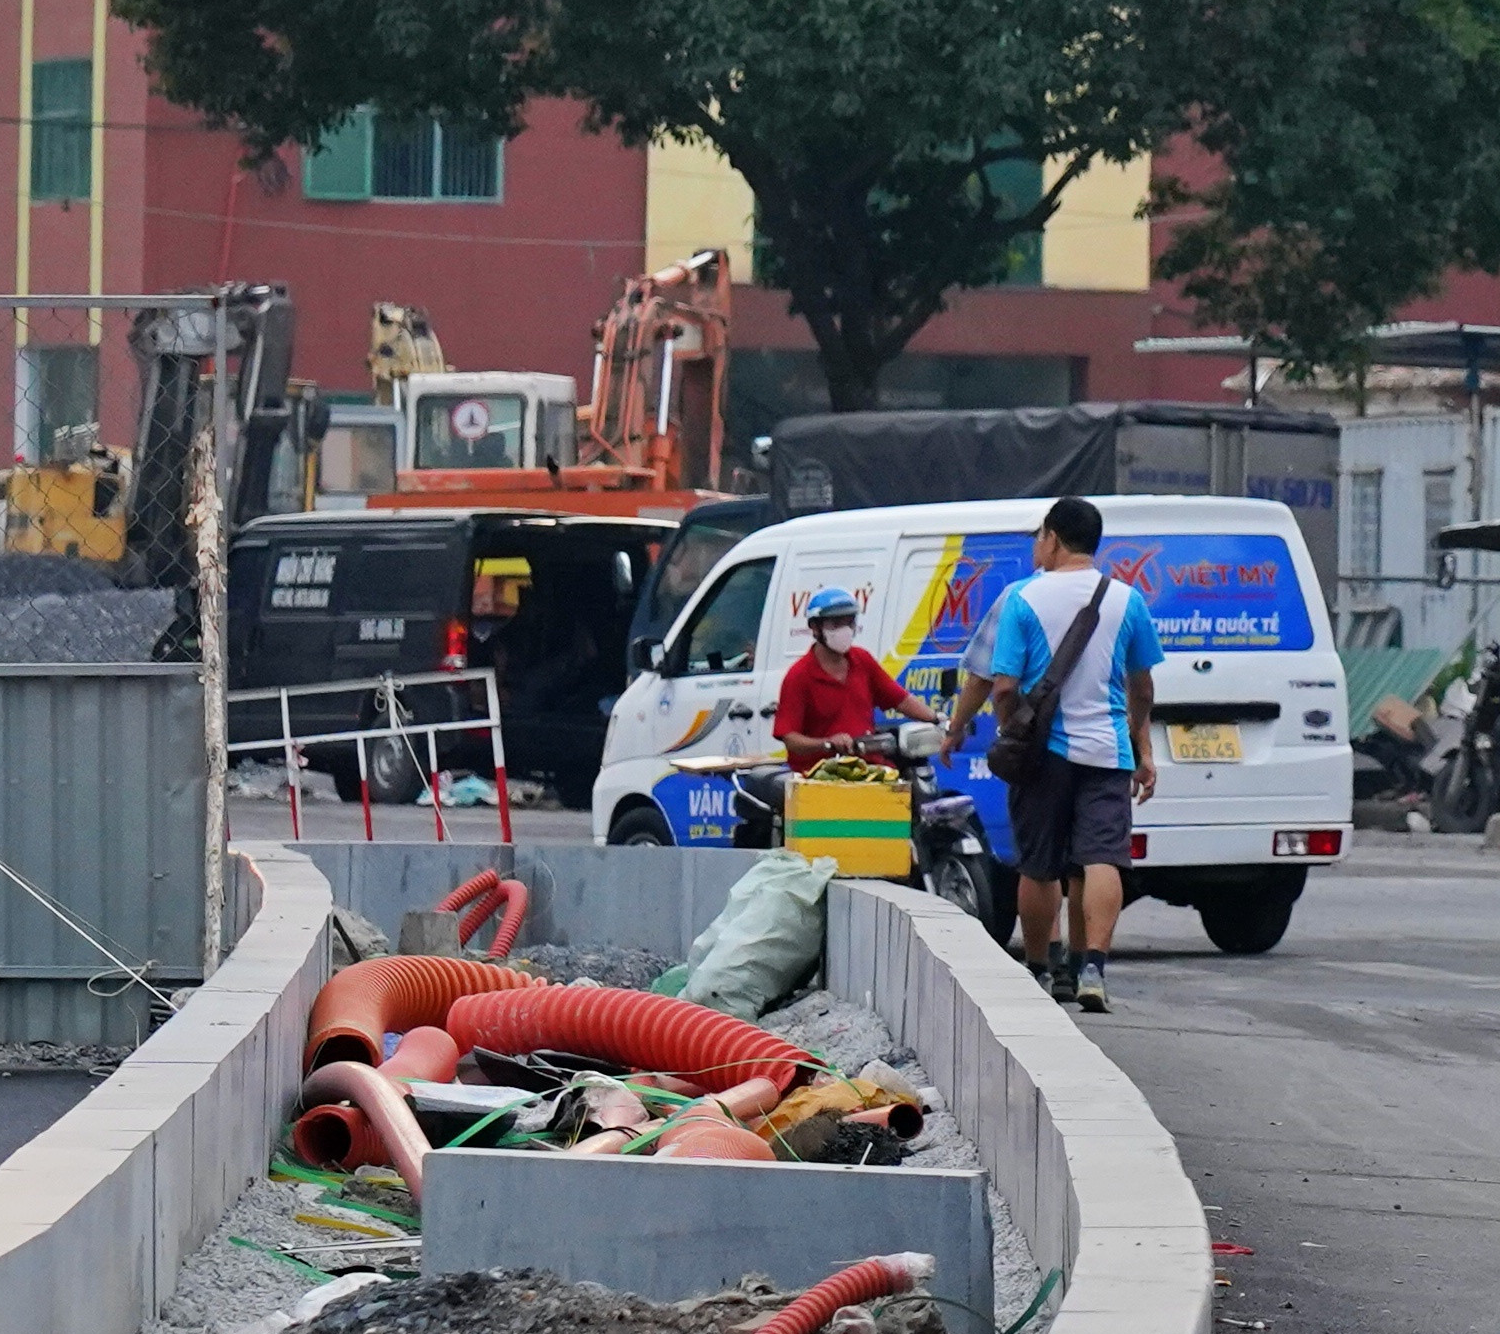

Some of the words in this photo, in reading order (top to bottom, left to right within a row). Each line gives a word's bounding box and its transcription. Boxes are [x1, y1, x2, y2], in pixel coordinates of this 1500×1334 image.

[1165, 560, 1234, 589] VIỆT
[1237, 560, 1280, 587] MỸ
[1179, 741, 1236, 760] 026.45
